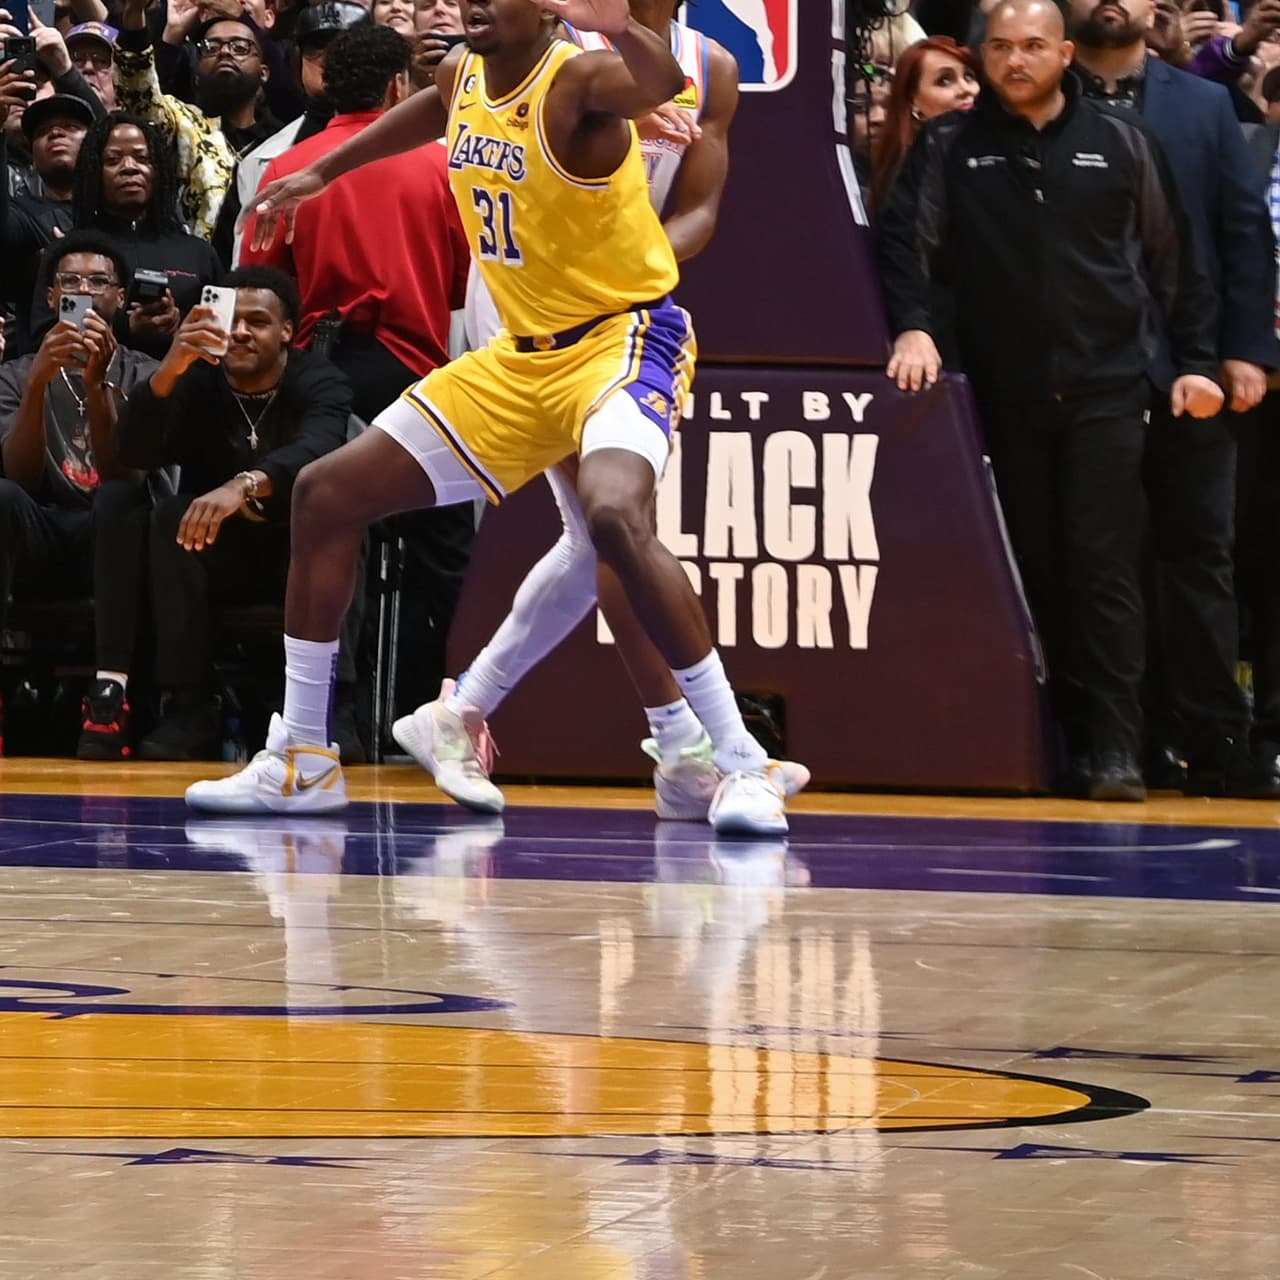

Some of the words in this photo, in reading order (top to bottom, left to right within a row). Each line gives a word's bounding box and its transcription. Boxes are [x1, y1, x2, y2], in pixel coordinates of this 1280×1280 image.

[449, 122, 525, 181] LAKERS
[471, 186, 521, 265] 31
[802, 391, 874, 423] BY
[656, 430, 880, 562] LACK
